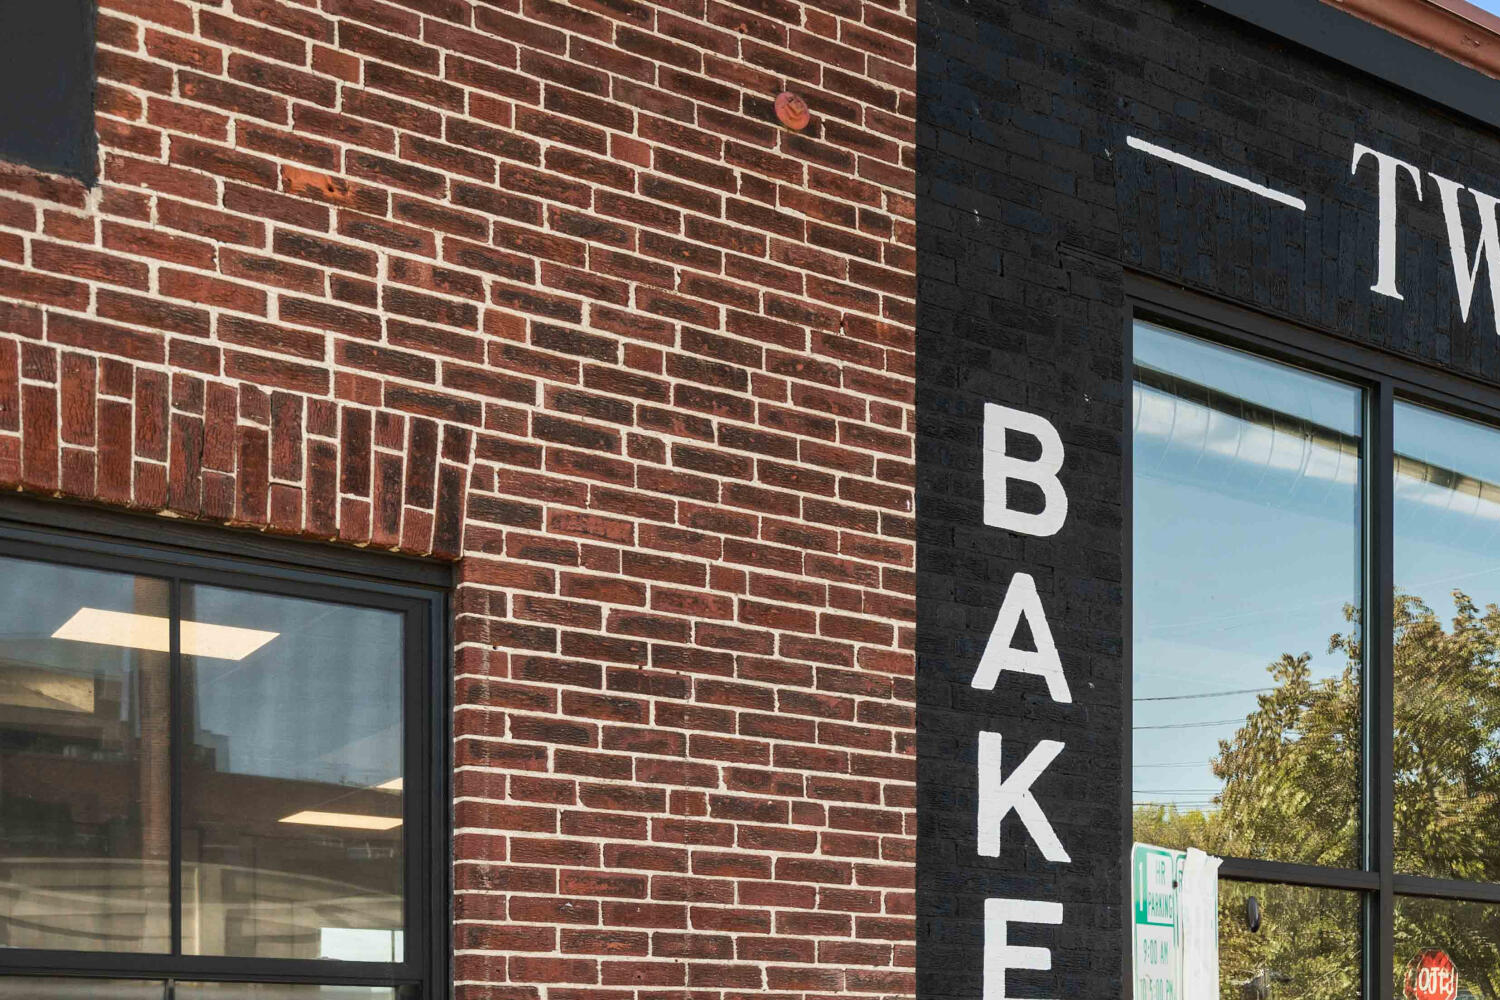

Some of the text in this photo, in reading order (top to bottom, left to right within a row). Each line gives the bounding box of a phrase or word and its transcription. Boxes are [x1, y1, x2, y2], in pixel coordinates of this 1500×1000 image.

[1138, 861, 1144, 912] 1
[1155, 860, 1166, 886] HR
[1148, 892, 1173, 919] PARKING
[1143, 938, 1169, 965] 9:00 AM
